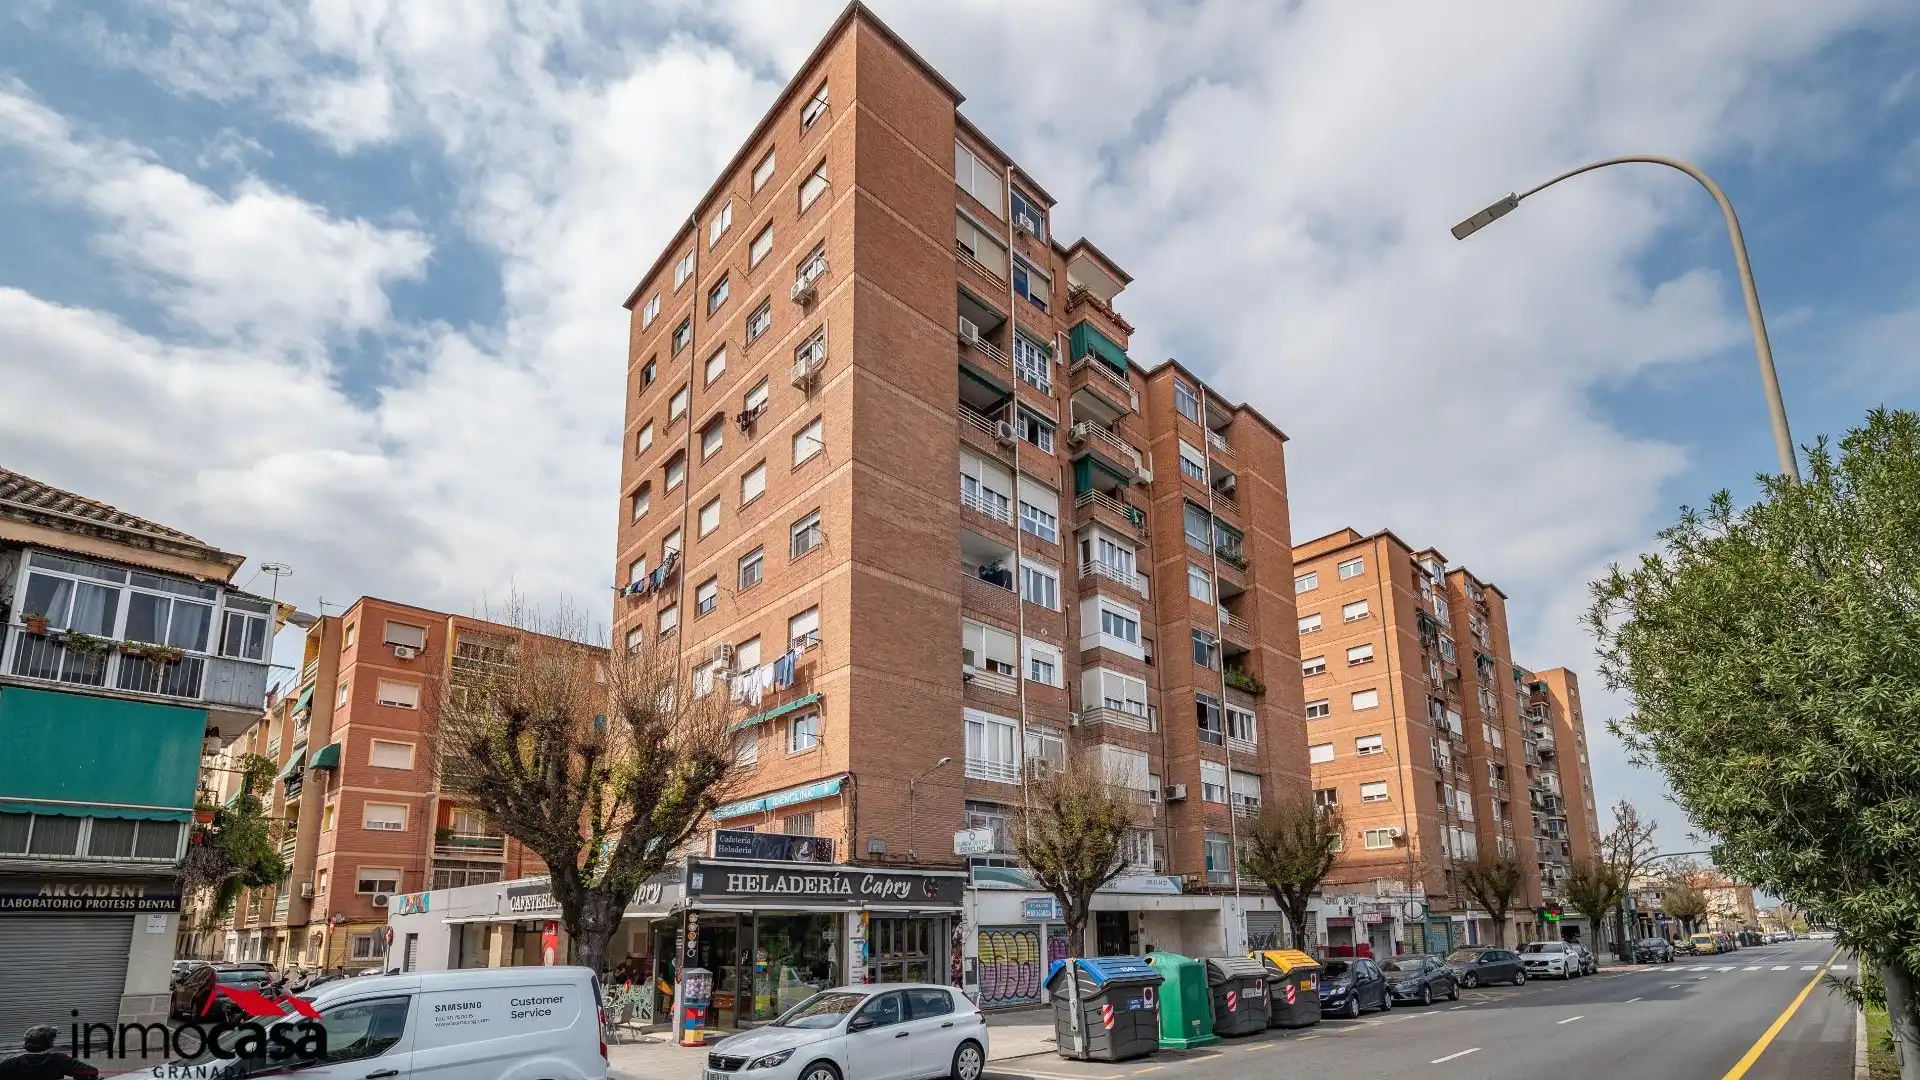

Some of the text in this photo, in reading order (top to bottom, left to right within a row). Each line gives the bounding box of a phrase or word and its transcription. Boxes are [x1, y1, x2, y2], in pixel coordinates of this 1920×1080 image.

[38, 883, 145, 897] ARCADENT
[725, 872, 911, 898] HELADERÍA Capry
[1, 898, 176, 909] LABORATORIO PROTESIS DENTAL
[434, 1001, 482, 1013] SAMSUNG
[510, 996, 564, 1007] Customer
[510, 1008, 552, 1019] Service
